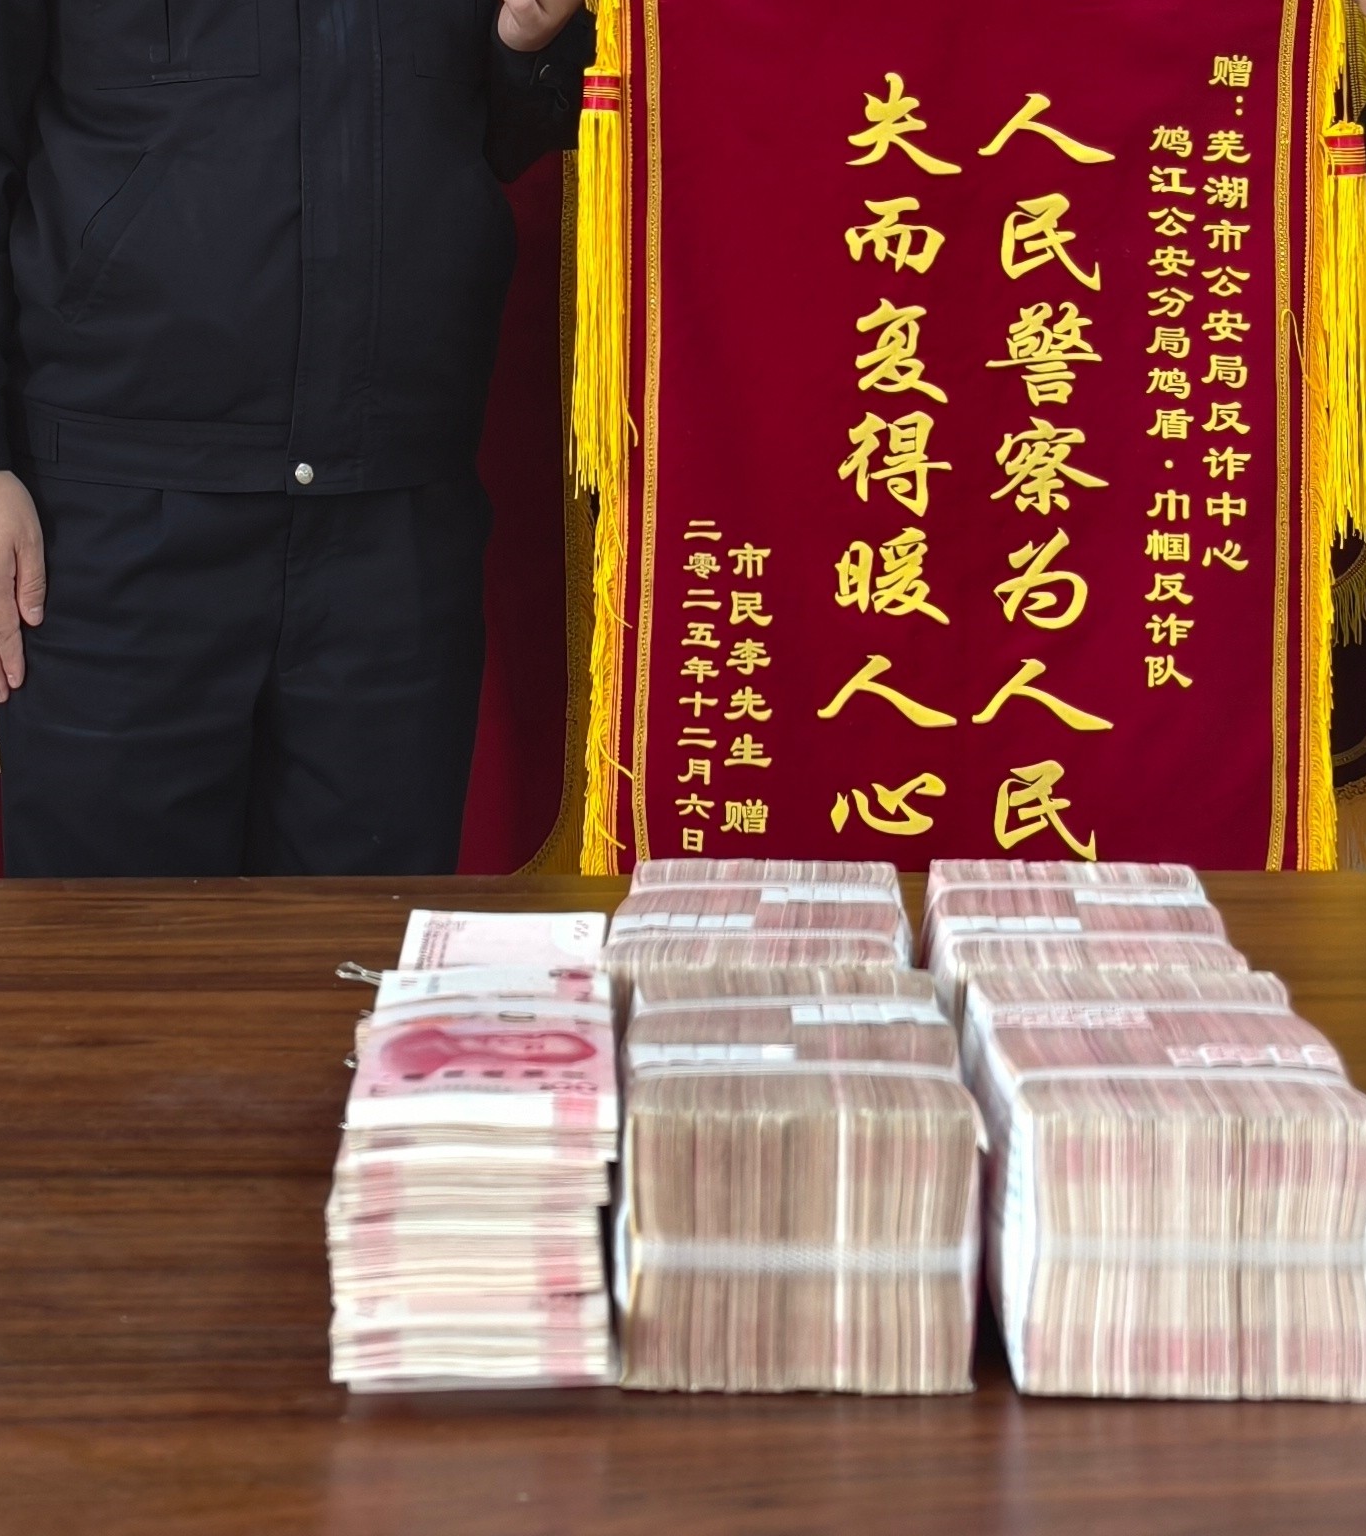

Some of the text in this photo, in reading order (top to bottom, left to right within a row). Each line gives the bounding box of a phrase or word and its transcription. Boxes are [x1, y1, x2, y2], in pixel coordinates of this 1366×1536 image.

[817, 71, 963, 836] 失而复得暖人心
[971, 92, 1116, 862] 人民警察为人民
[1201, 54, 1252, 572] 赠：芜湖市公安局反诈中心
[675, 520, 723, 853] 二零二五年十二月六日
